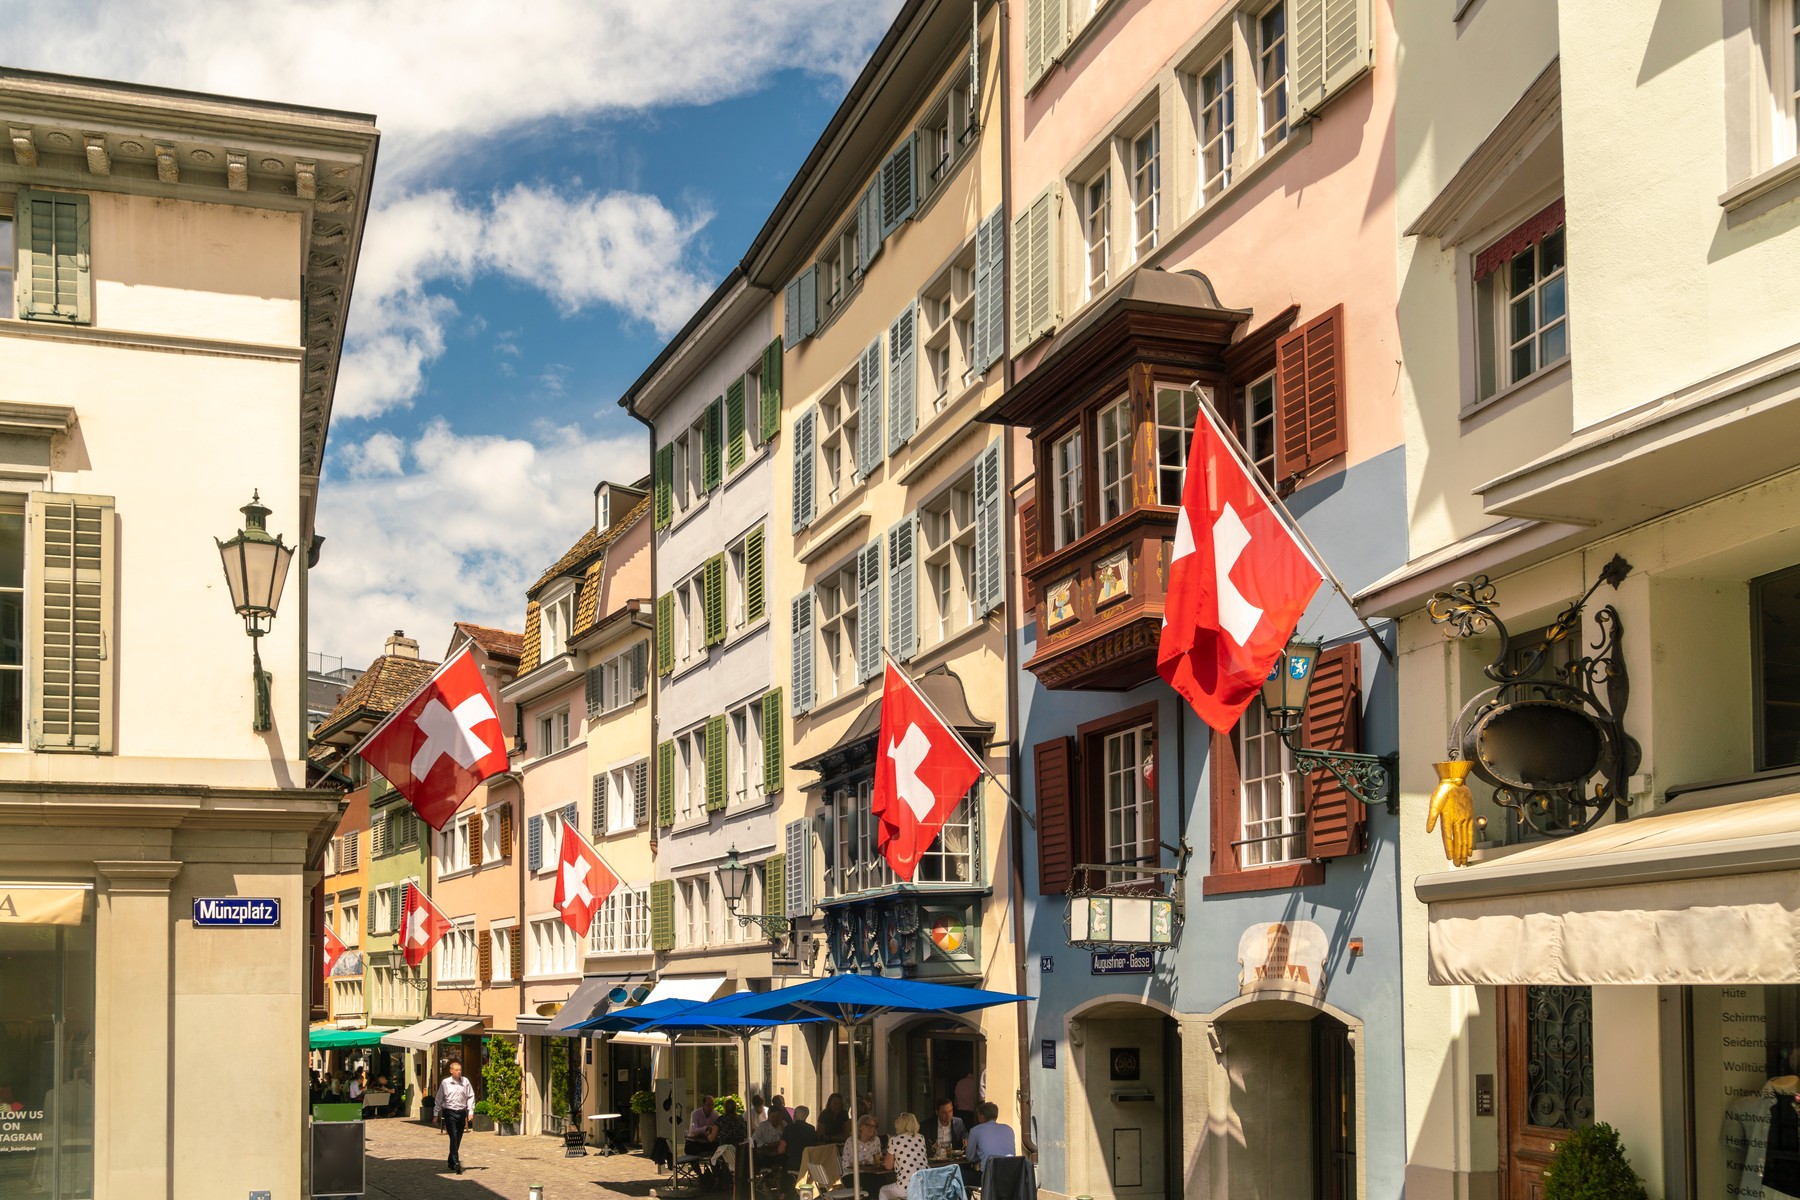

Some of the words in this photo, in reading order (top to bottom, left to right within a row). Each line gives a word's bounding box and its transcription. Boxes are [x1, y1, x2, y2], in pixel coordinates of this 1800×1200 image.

[200, 900, 273, 924] Münzplatz
[1042, 959, 1051, 970] 24
[1721, 988, 1746, 998] Hüte
[1722, 1012, 1767, 1022] Schirme
[29, 1111, 44, 1119] US
[1725, 1111, 1771, 1124] Nachtwä
[2, 1122, 21, 1131] ON
[1726, 1159, 1766, 1174] Krawat
[1726, 1183, 1766, 1199] Socken
